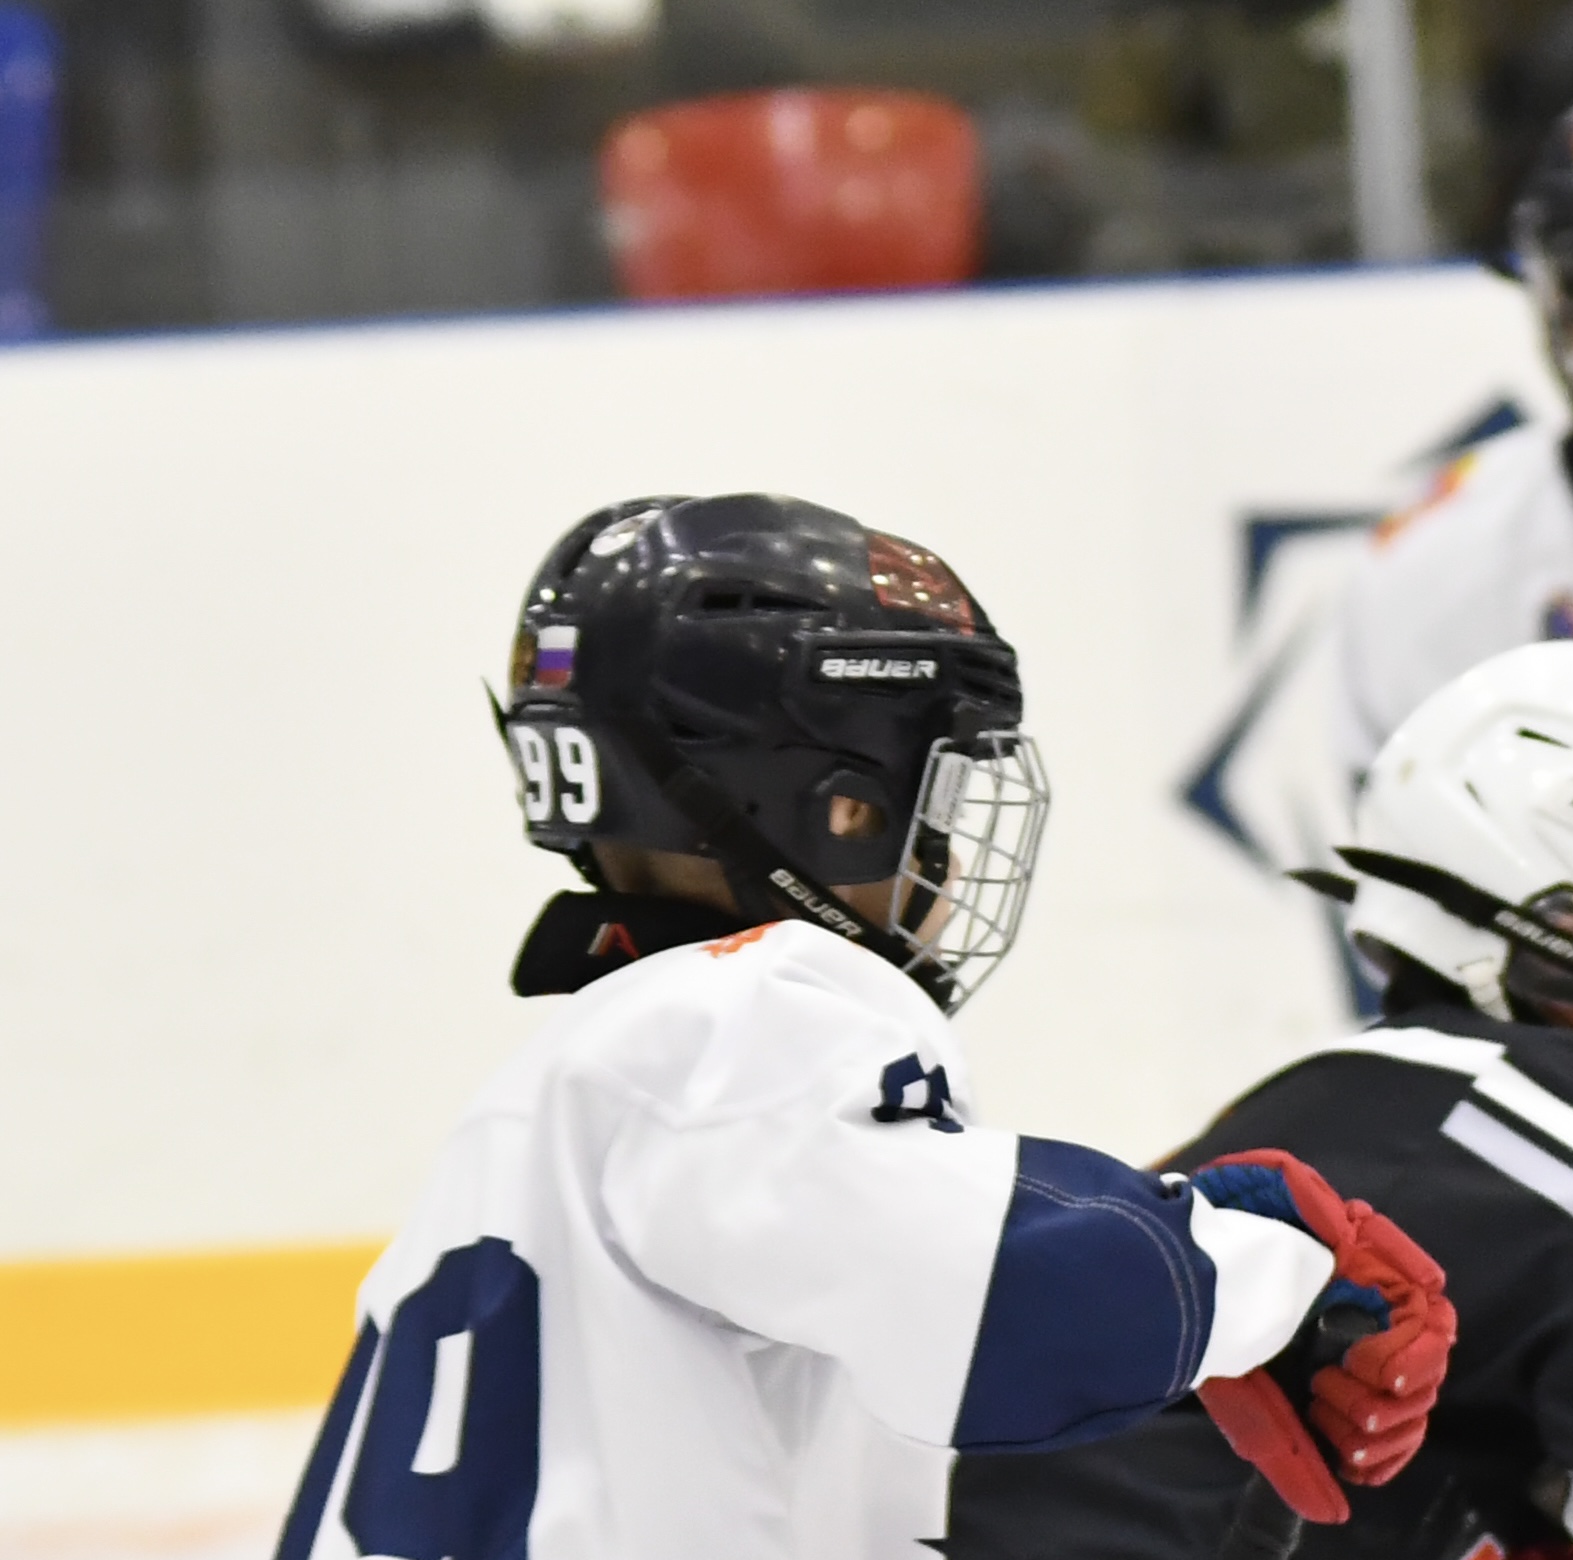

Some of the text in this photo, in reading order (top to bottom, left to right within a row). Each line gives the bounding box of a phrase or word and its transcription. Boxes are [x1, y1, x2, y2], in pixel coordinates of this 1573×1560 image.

[819, 657, 940, 679] BAUER
[512, 726, 600, 823] 99
[768, 868, 864, 937] BAUER
